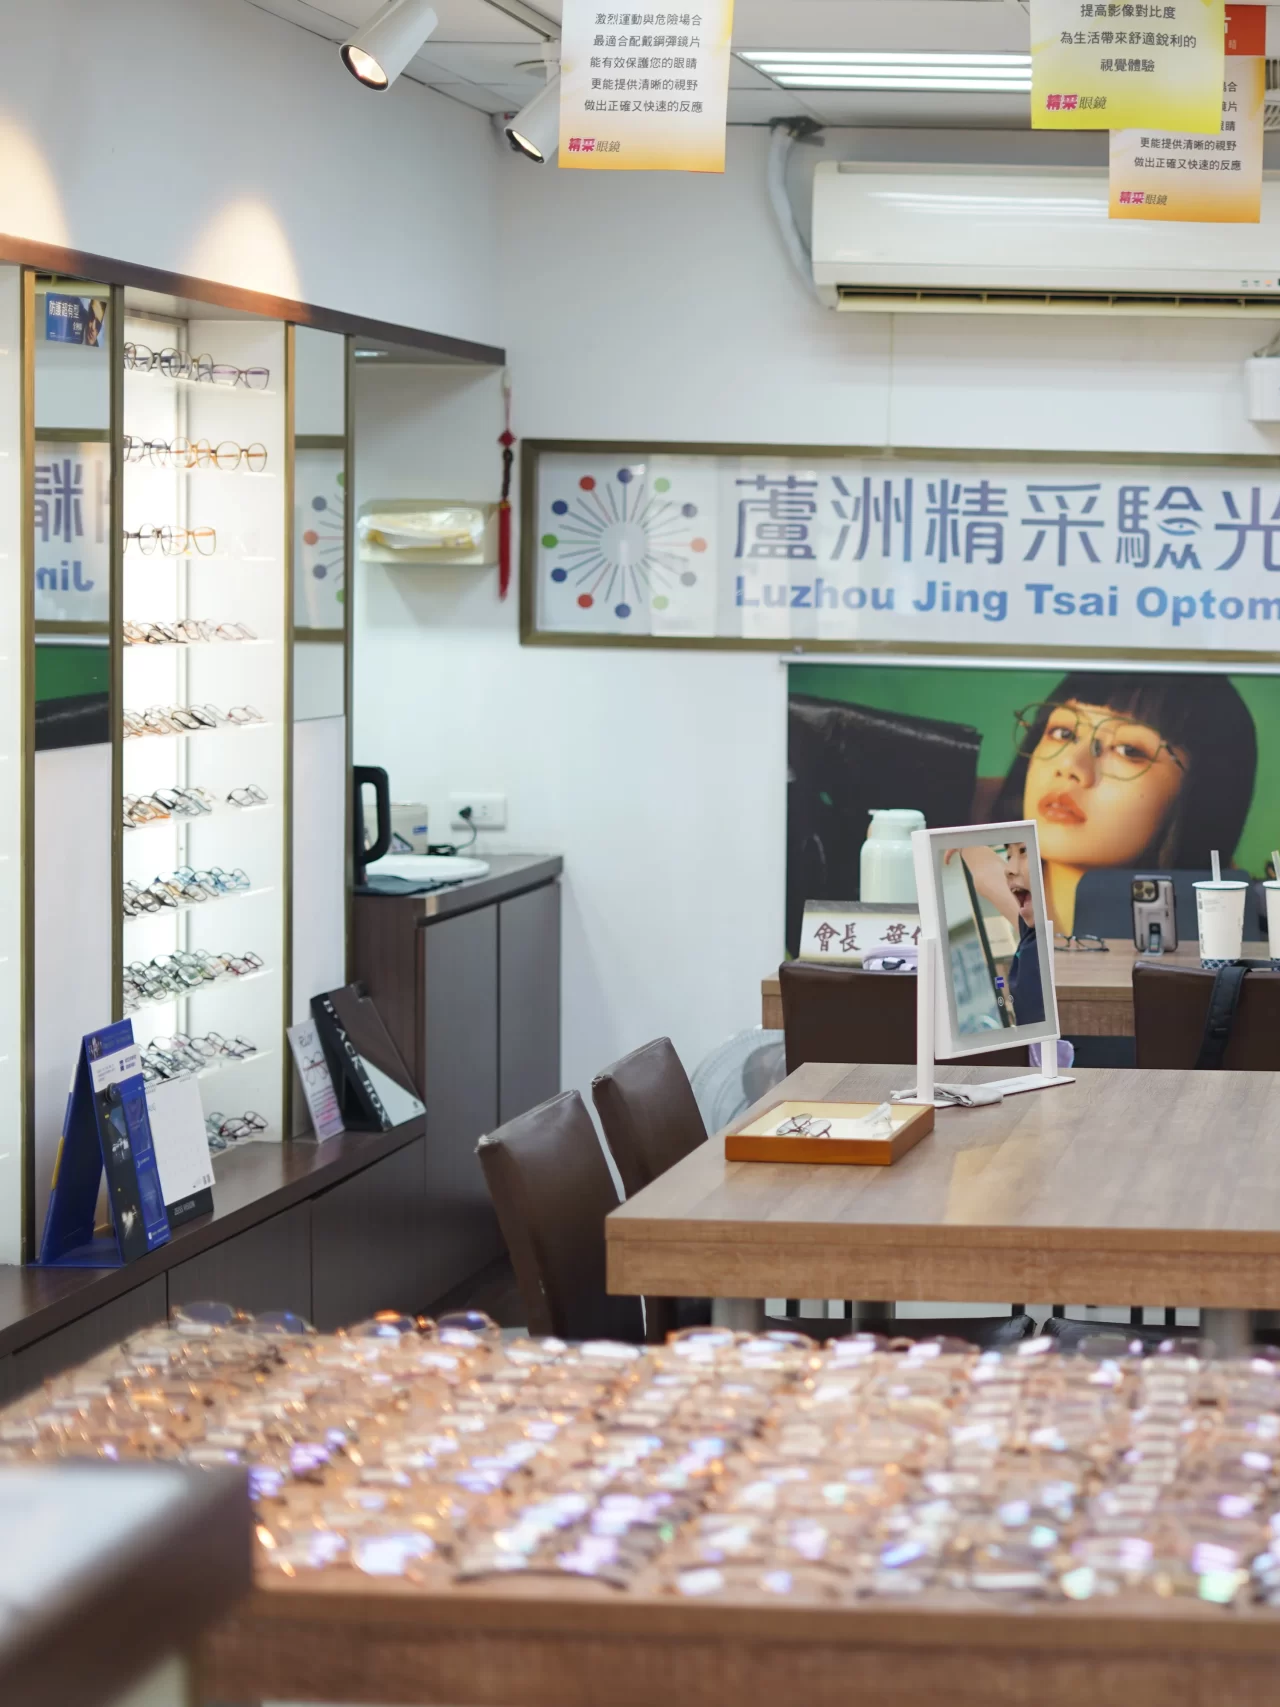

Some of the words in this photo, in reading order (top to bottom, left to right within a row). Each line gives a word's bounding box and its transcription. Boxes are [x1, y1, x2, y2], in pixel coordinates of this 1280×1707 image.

[1080, 4, 1177, 20] 提高影像對比度
[594, 13, 703, 27] 激烈運動與危險場合
[592, 34, 701, 48] 最適合配戴鋼彈鏡片
[1060, 31, 1197, 49] 為生活帶來舒適銳利的
[589, 56, 698, 70] 能有效保護您的眼睛
[1100, 58, 1155, 73] 視覺體驗
[591, 77, 699, 92] 更能提供清晰的視野
[584, 99, 704, 114] 做出正確又快速的反應
[1140, 136, 1237, 152] 更能提供清晰的視野
[1134, 157, 1242, 171] 做出正確又快速的反應
[735, 575, 895, 611] Luzhou
[912, 580, 1008, 622] Jing
[1024, 583, 1118, 617] Tsai
[813, 922, 861, 953] 會長
